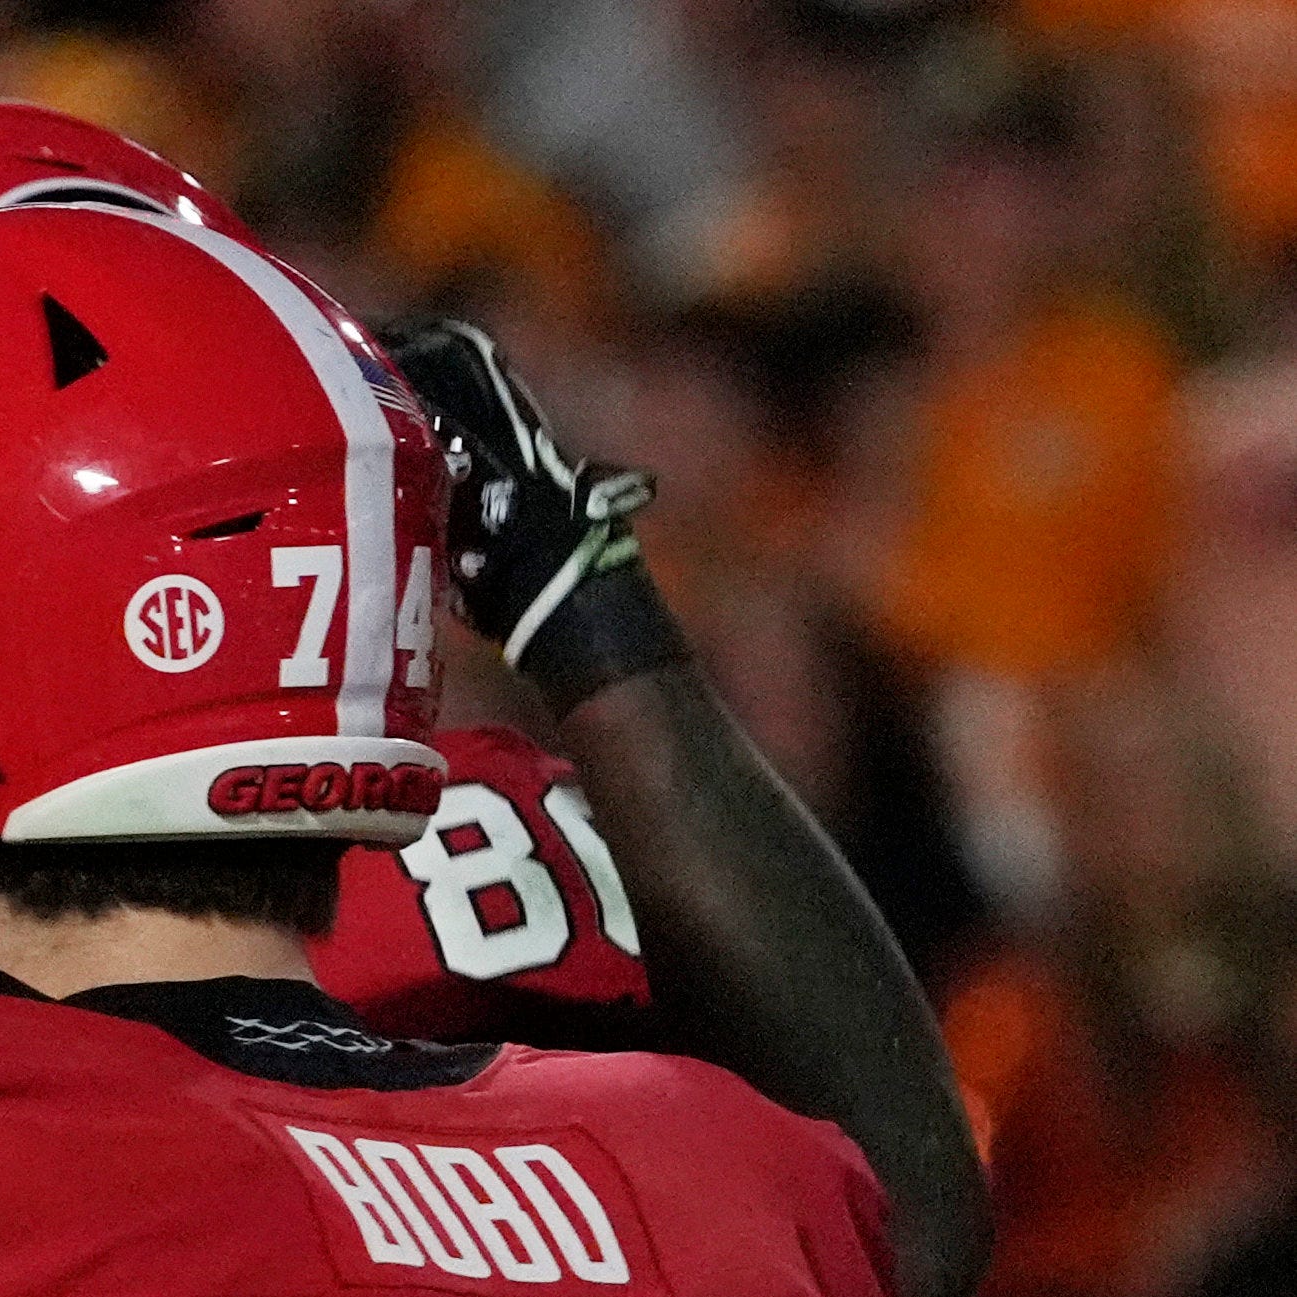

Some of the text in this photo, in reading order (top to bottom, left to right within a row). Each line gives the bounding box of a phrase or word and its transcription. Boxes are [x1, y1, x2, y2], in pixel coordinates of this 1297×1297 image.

[137, 586, 214, 660] SEC
[270, 546, 434, 687] 74
[287, 1126, 631, 1285] BOBO
